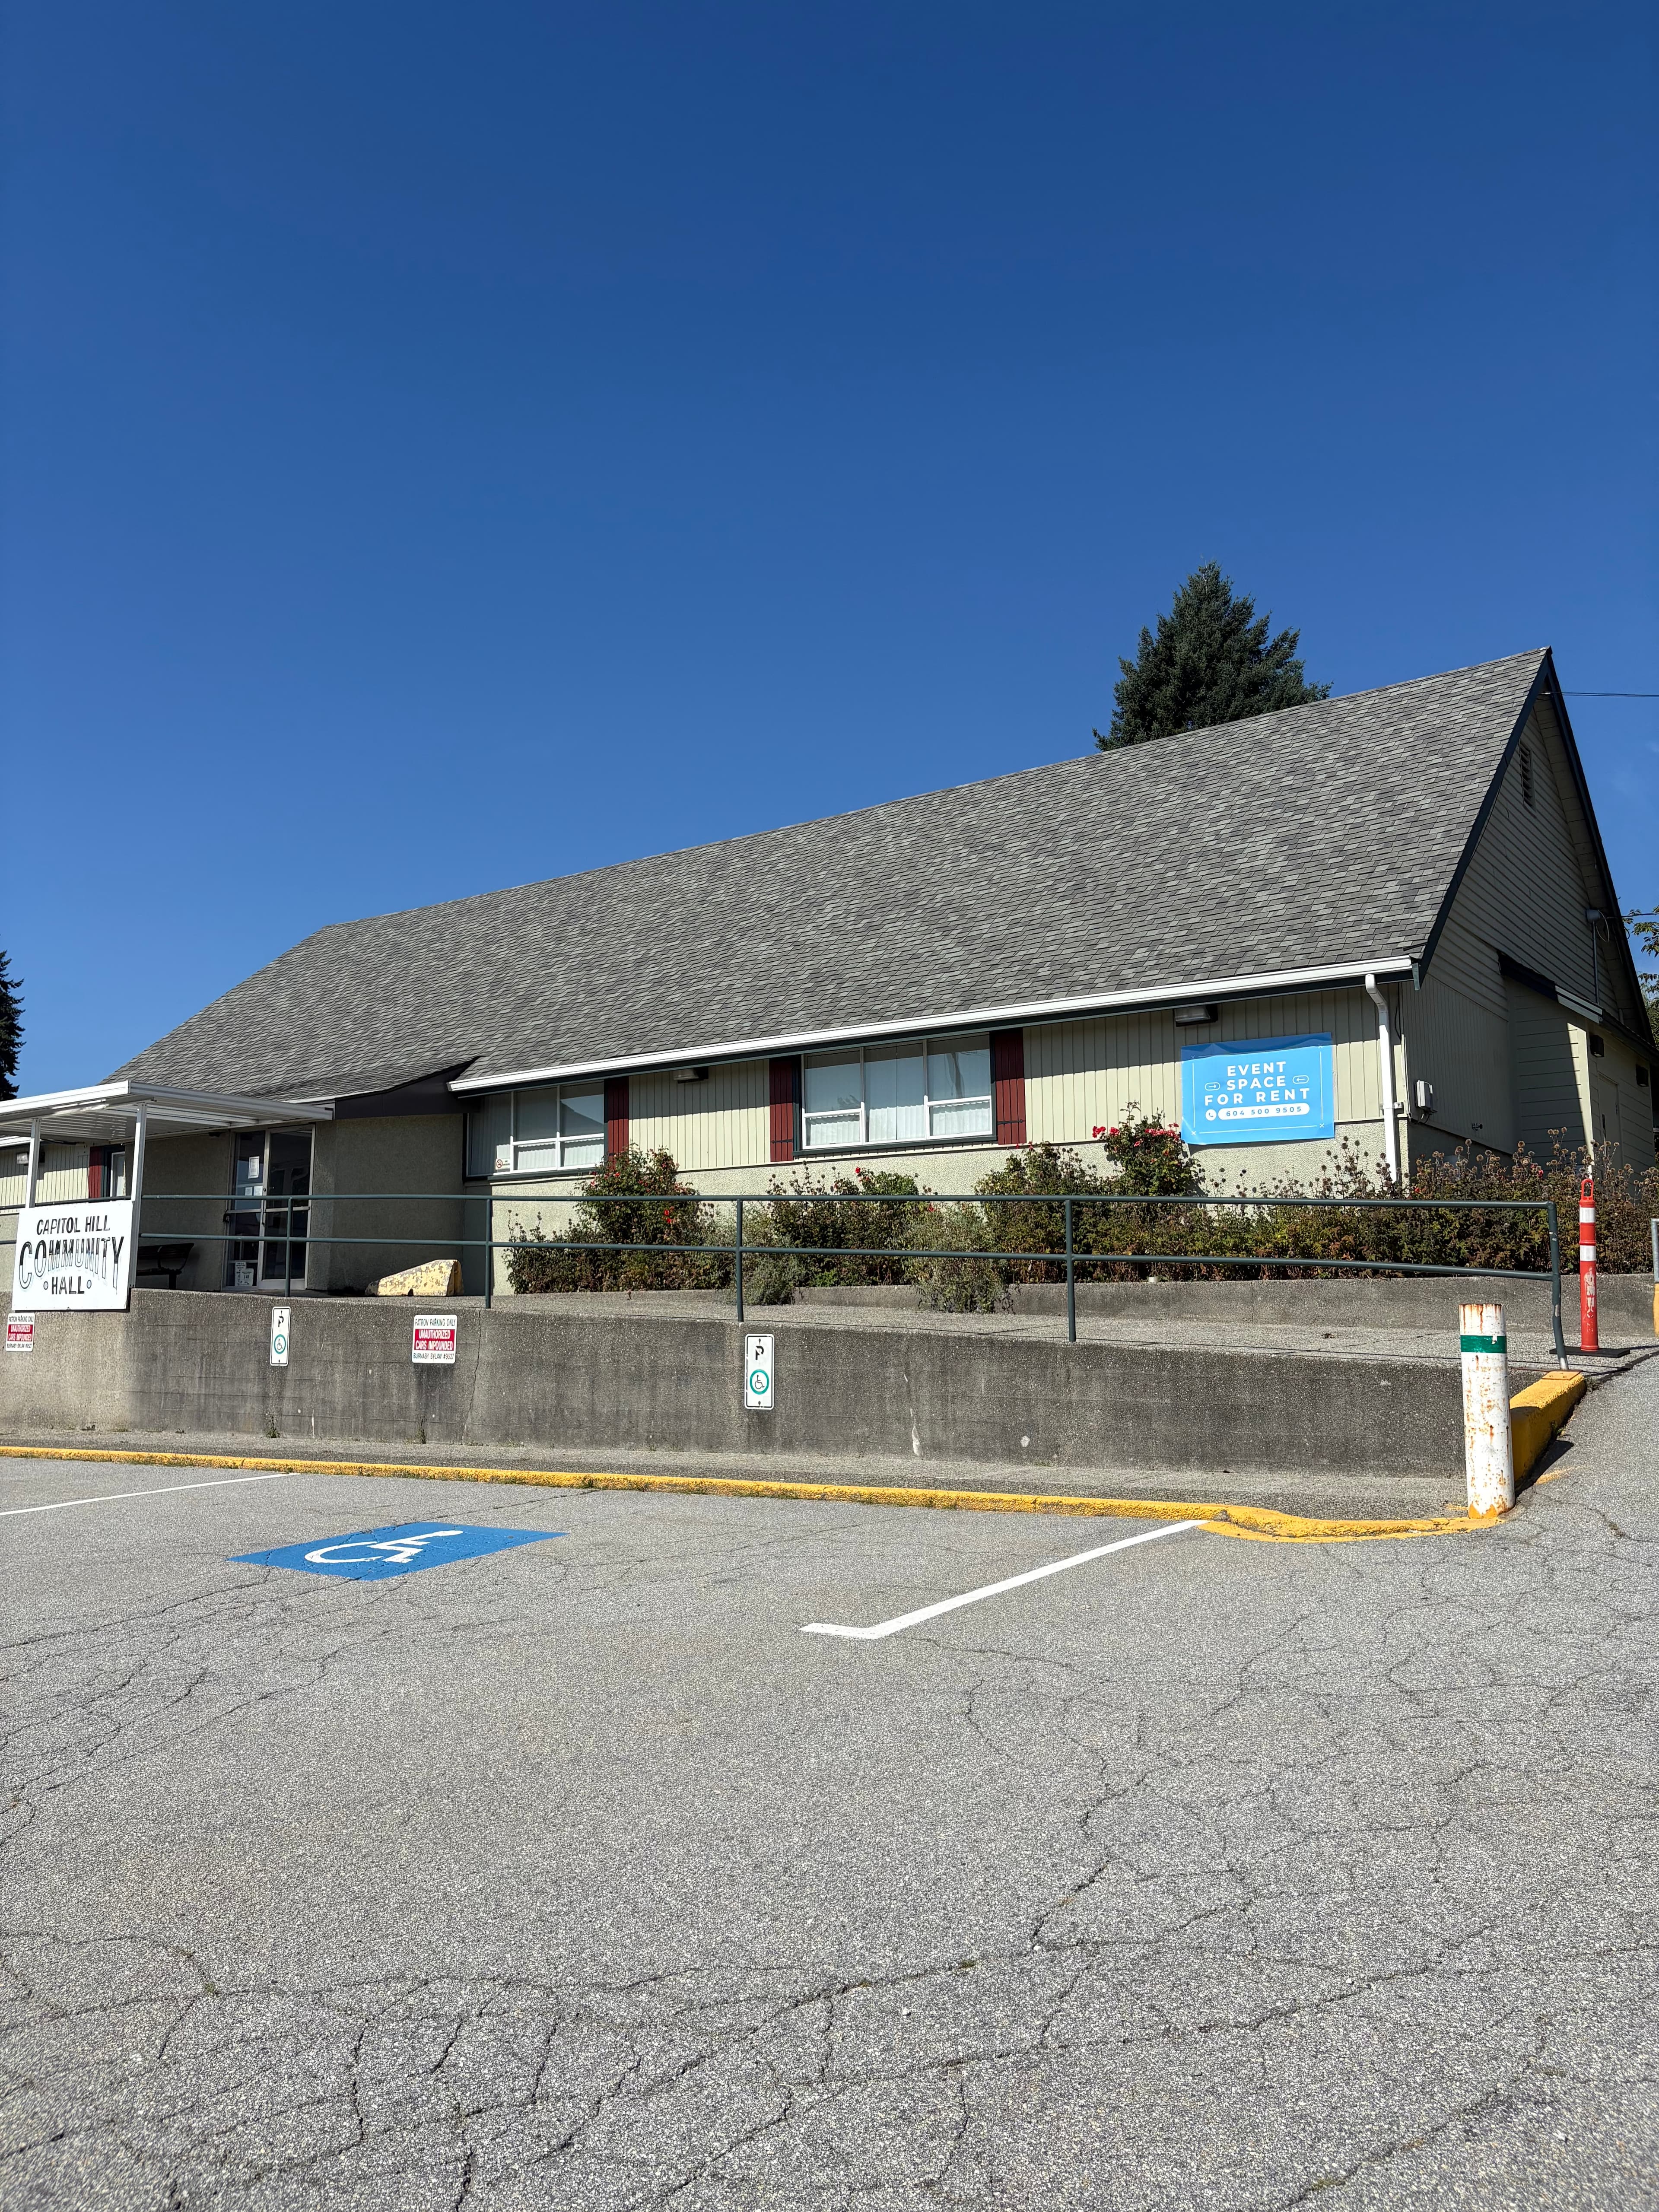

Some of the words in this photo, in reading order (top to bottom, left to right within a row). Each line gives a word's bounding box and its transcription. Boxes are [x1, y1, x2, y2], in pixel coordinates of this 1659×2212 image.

[1227, 1061, 1286, 1077] EVENT
[1227, 1075, 1286, 1090] SPACE
[1205, 1093, 1243, 1106] FOR
[1256, 1088, 1309, 1103] RENT
[37, 1217, 80, 1235] CAPITOL
[85, 1215, 110, 1232] HILL
[19, 1236, 124, 1289] COMMUNITY
[51, 1276, 85, 1294] HALL
[419, 1329, 451, 1339] UNAUTHORIZED
[415, 1340, 427, 1350] CARS
[428, 1340, 453, 1351] IMPOUNDED
